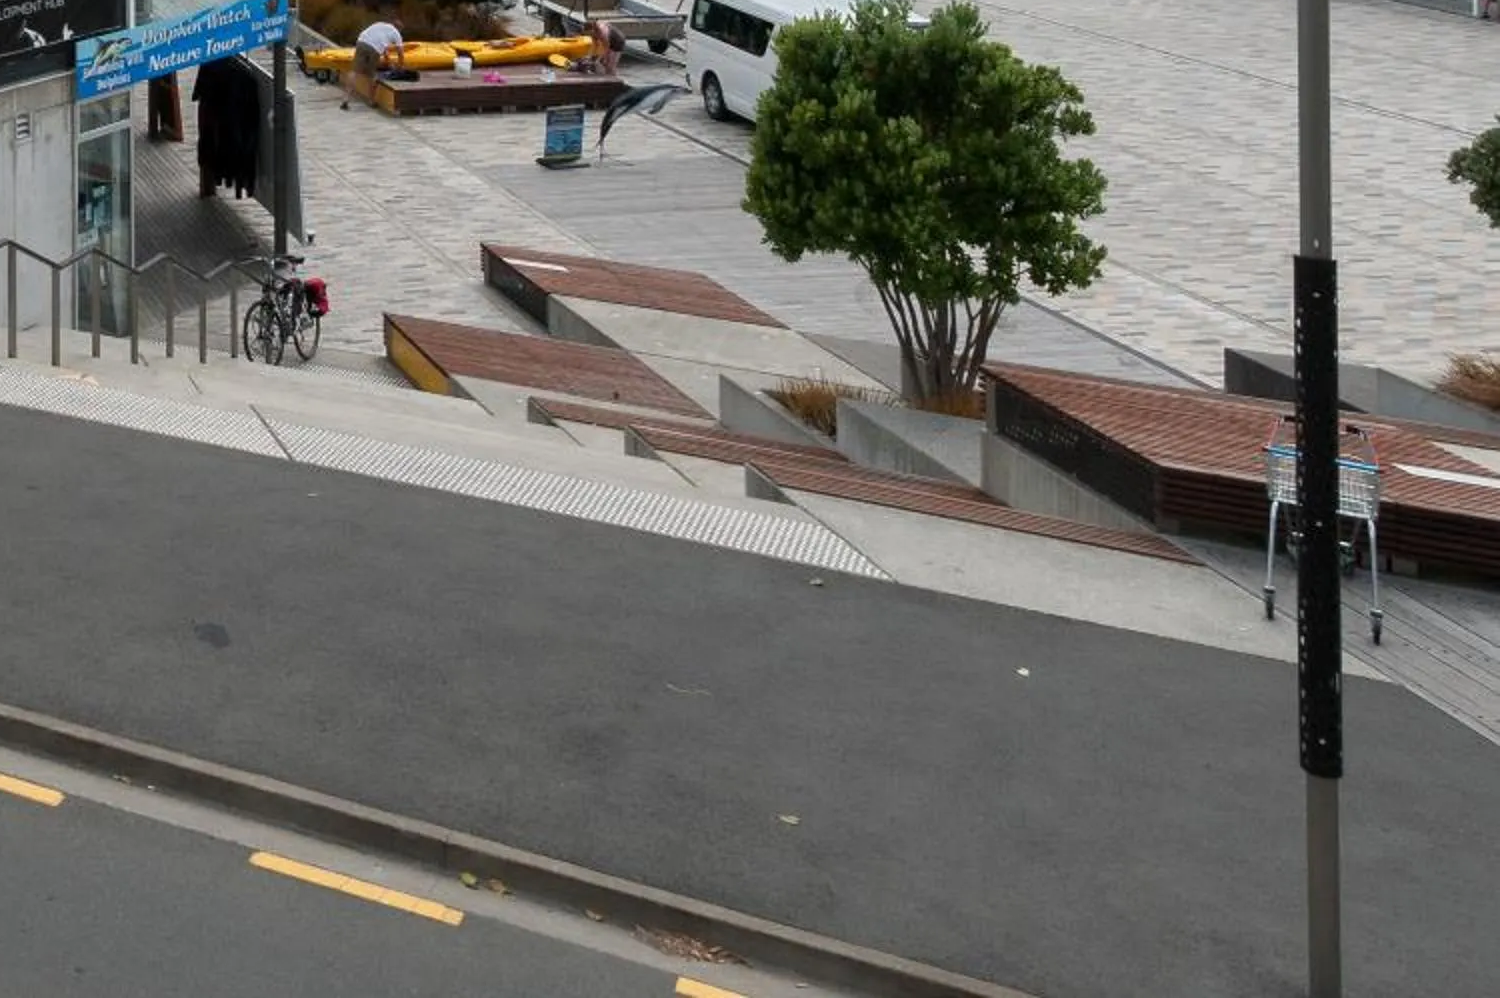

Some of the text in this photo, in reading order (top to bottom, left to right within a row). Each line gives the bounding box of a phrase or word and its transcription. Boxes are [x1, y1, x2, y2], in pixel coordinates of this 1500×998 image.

[141, 4, 251, 47] Dolphin Watch
[149, 44, 201, 72] Nature
[205, 34, 245, 57] Tours
